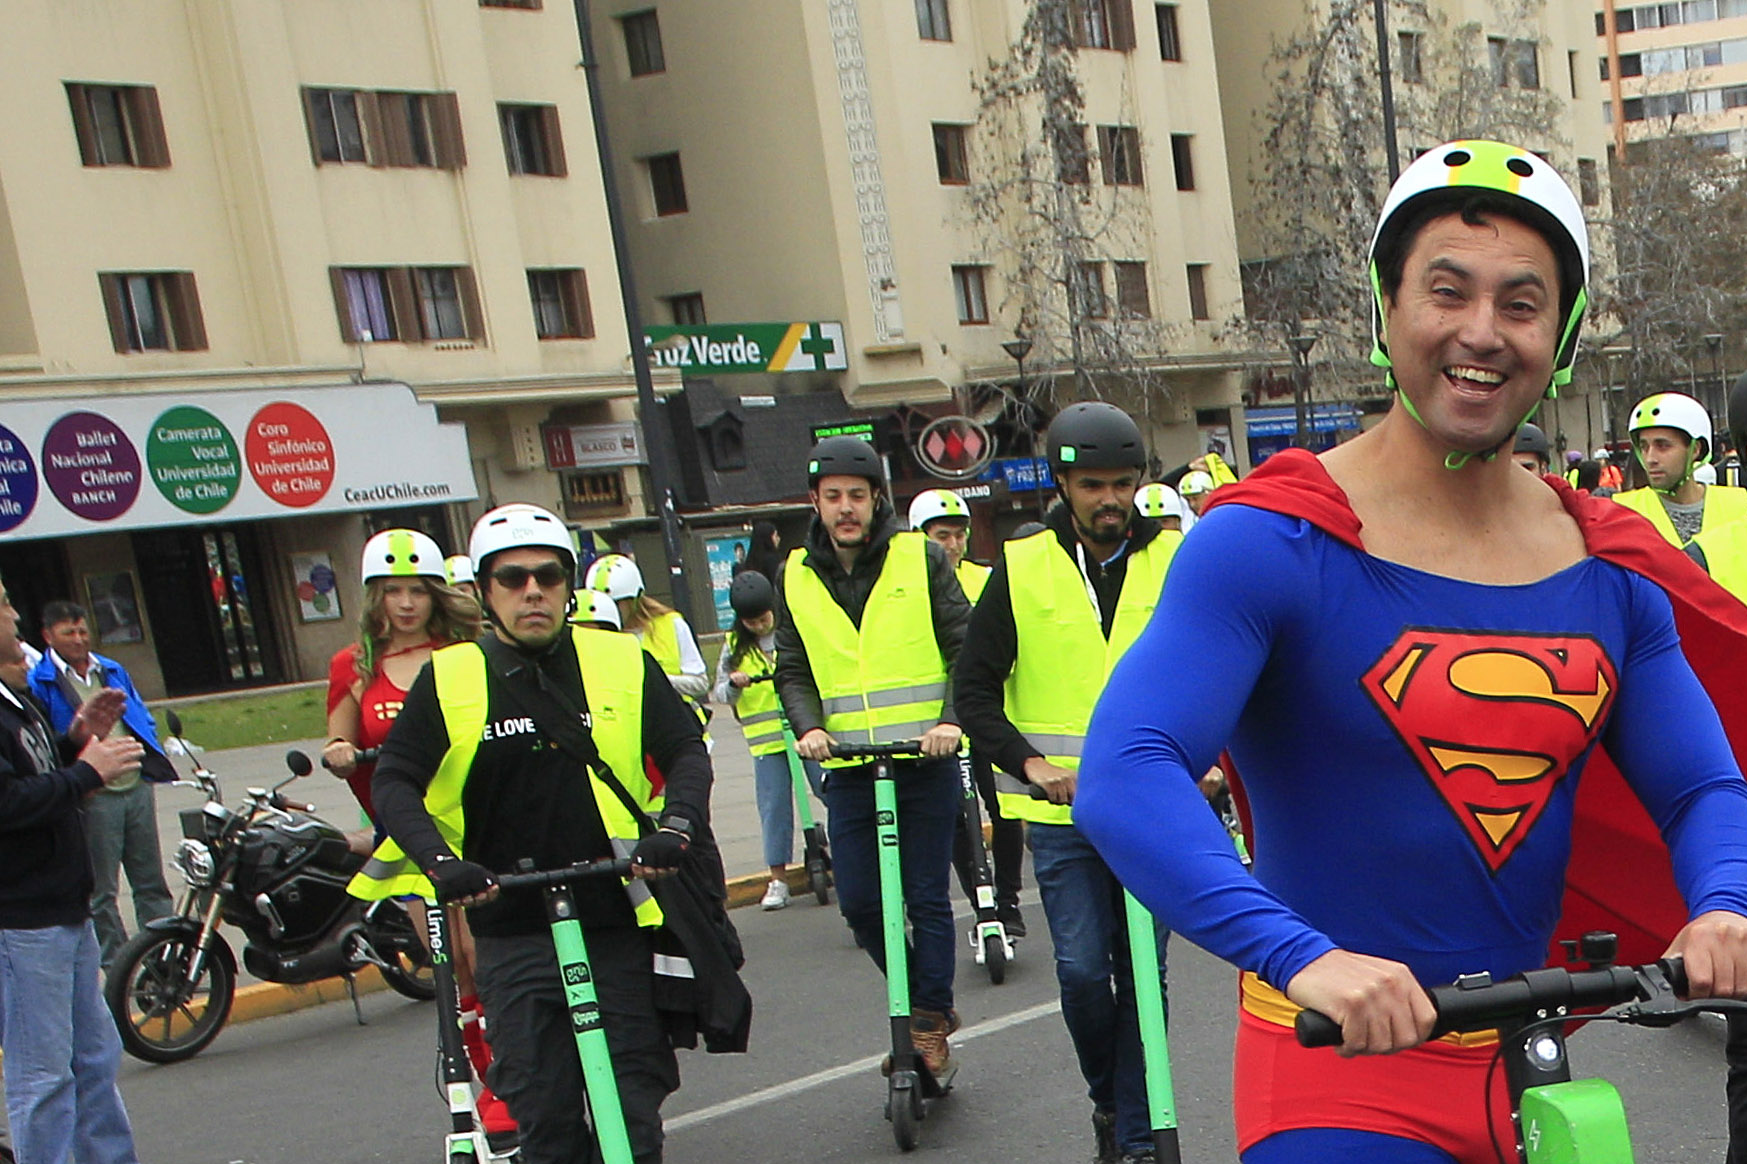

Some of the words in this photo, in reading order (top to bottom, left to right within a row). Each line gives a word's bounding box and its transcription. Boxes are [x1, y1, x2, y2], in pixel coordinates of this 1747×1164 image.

[691, 334, 760, 365] Verde
[157, 426, 222, 443] Camerata
[257, 422, 289, 437] Coro
[76, 432, 117, 448] Ballet
[267, 438, 326, 456] Sinfónico
[51, 450, 112, 469] Nacional
[191, 444, 228, 461] Vocal
[157, 461, 236, 482] Universidad
[255, 457, 329, 476] Universidad
[80, 469, 134, 487] Chileno
[272, 478, 289, 494] de
[290, 476, 321, 493] Chile
[72, 490, 116, 505] BANCH
[175, 485, 193, 500] de
[195, 482, 228, 499] Chile
[344, 483, 451, 503] CeacUChile.com
[495, 717, 536, 738] LOVE
